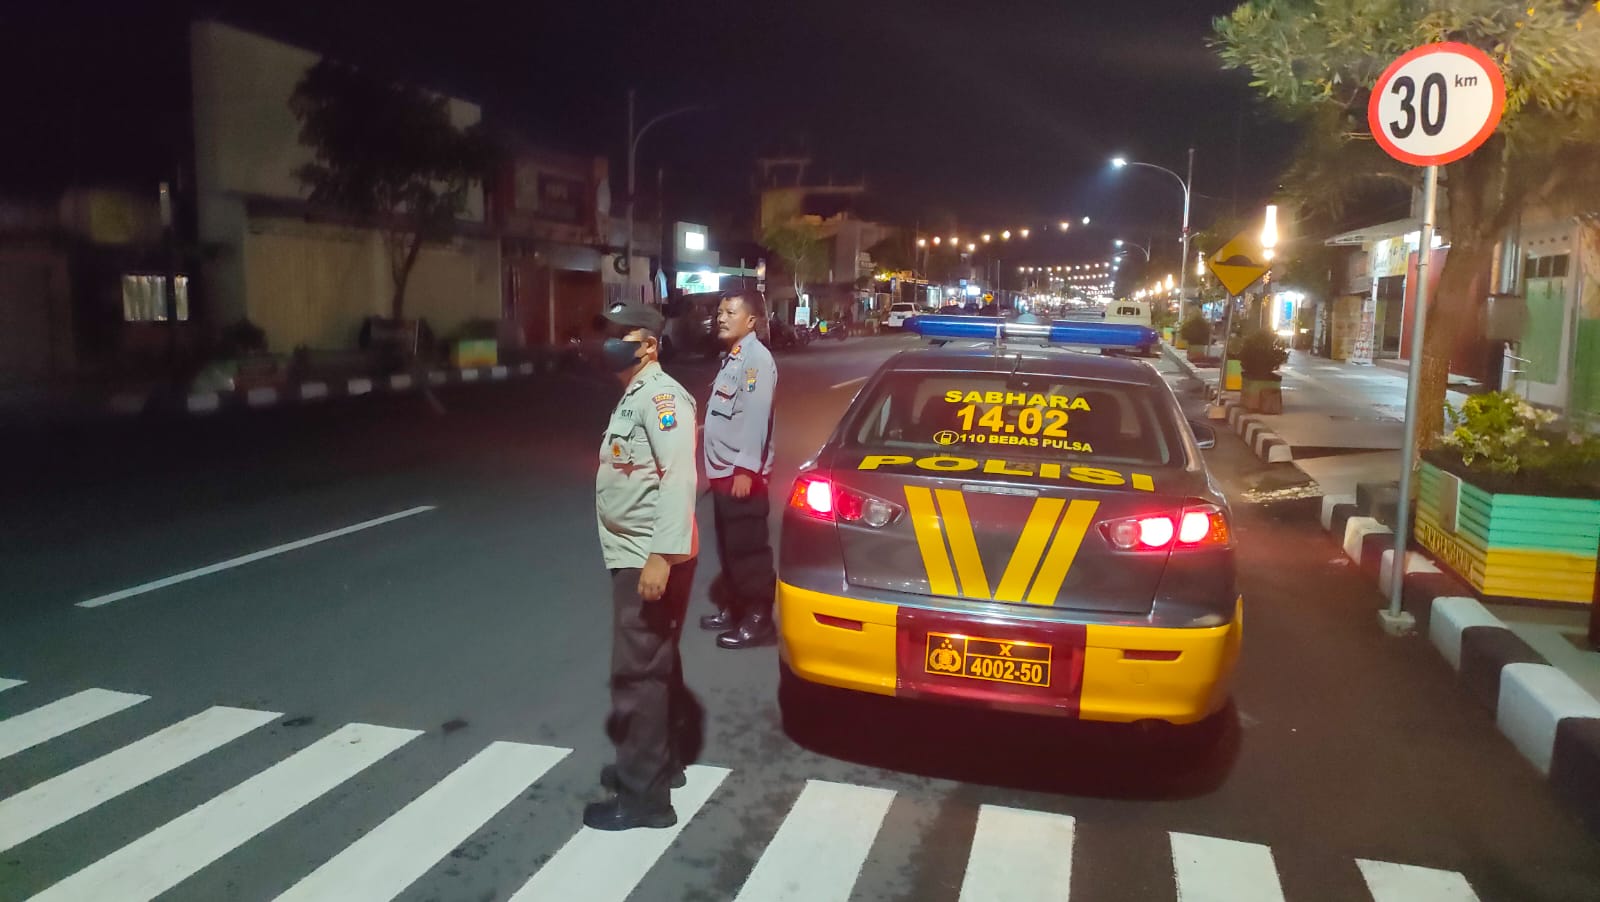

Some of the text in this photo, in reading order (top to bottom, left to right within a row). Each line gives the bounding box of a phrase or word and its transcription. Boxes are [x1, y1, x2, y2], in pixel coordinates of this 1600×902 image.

[1389, 72, 1478, 139] 30 km
[944, 390, 1091, 412] SABHARA
[957, 404, 1069, 438] 14.02
[959, 433, 1093, 453] 110 BEBAS PULSA
[857, 455, 1155, 492] POLISI
[999, 644, 1013, 656] X
[970, 658, 1042, 682] 4002-50
